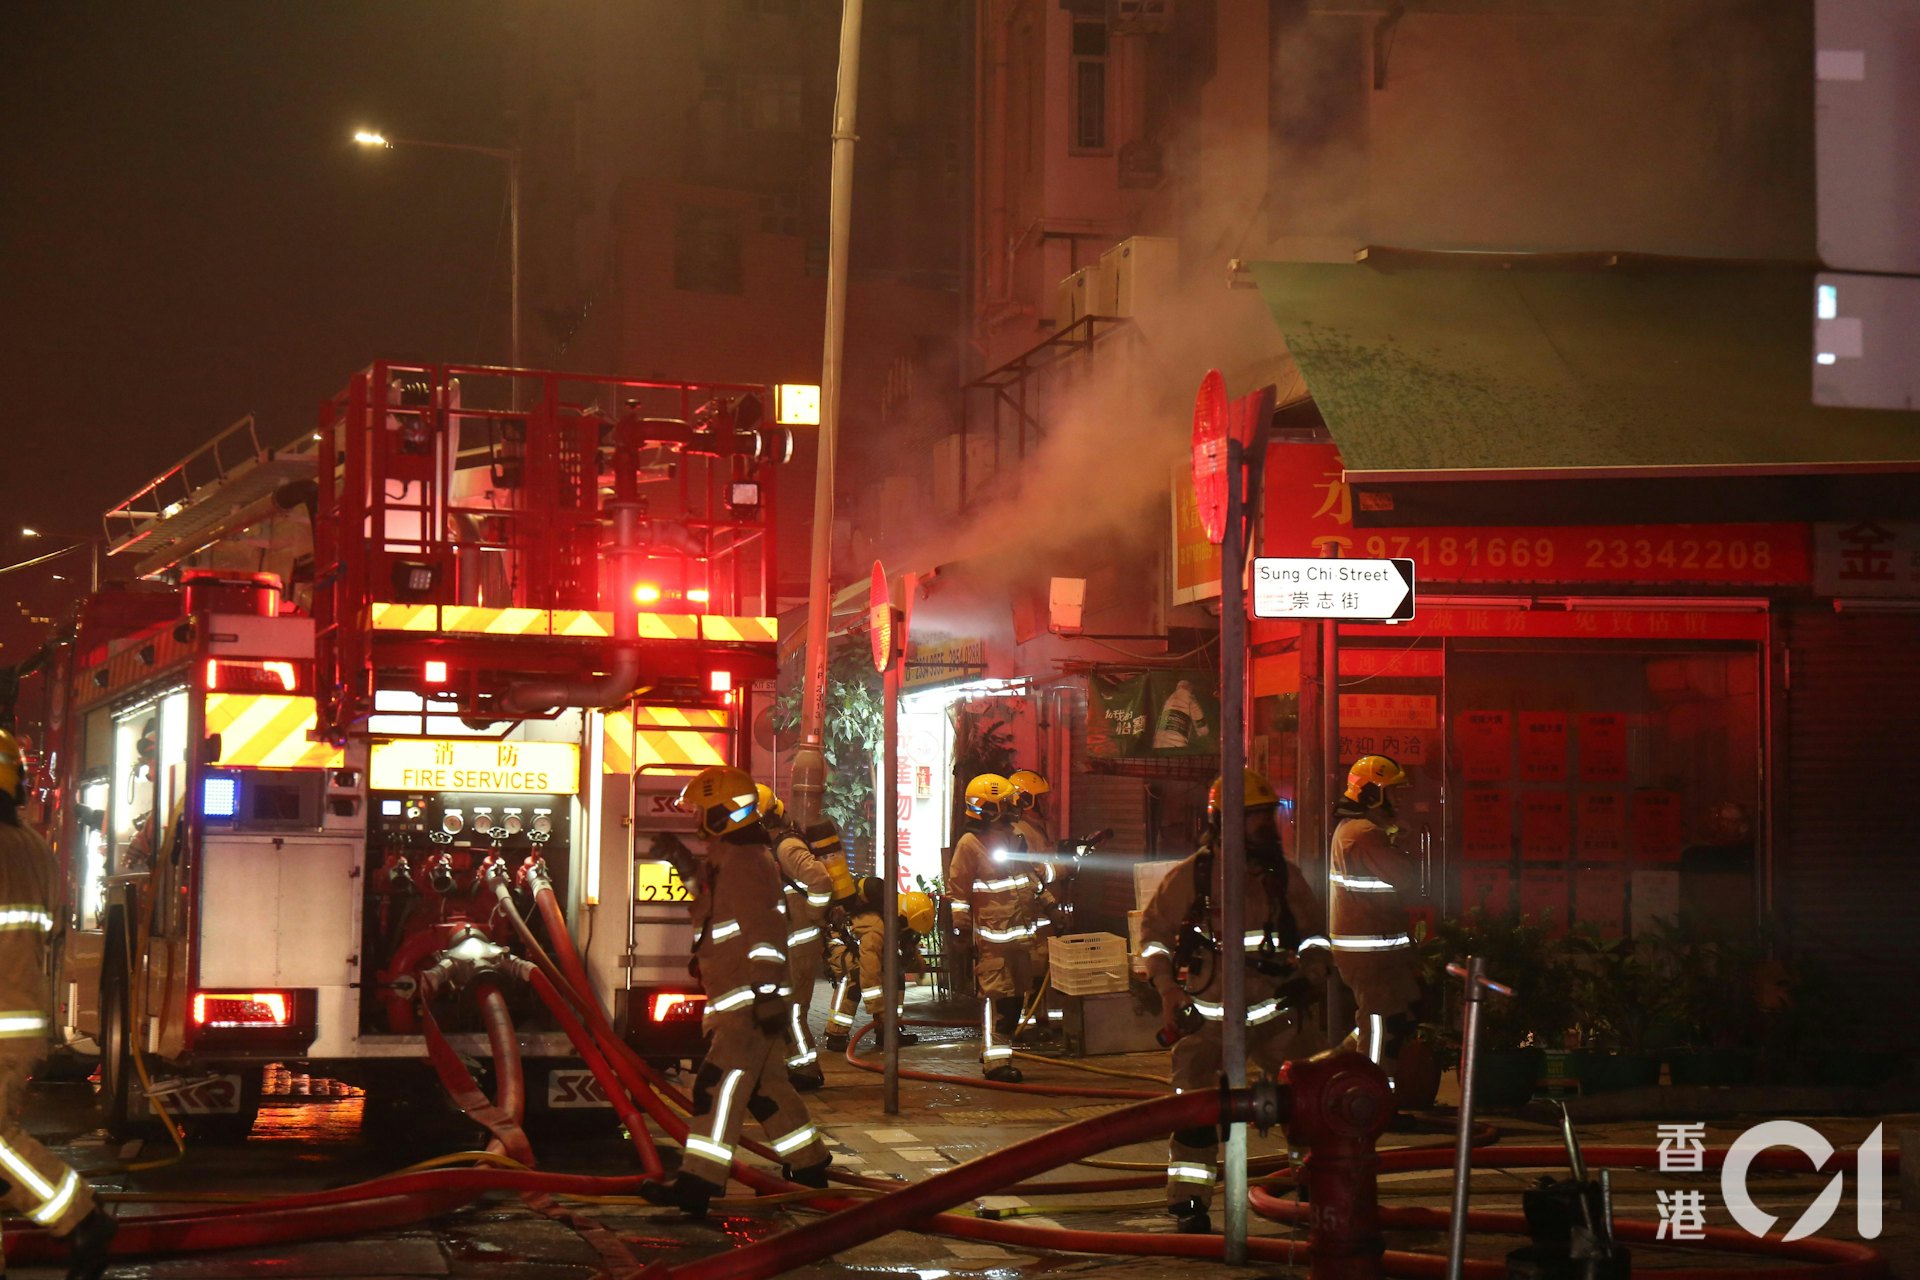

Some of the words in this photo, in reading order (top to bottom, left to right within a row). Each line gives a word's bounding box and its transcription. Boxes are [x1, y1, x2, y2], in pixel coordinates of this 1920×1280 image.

[1366, 536, 1555, 568] 97181669
[1585, 538, 1772, 571] 23342208
[1838, 519, 1896, 580] 金
[1260, 566, 1300, 583] Sung
[1306, 566, 1332, 581] Chi
[1339, 567, 1389, 582] Street
[1291, 591, 1360, 611] 崇志街
[435, 743, 519, 767] 消防
[402, 769, 447, 788] FIRE
[452, 770, 549, 790] SERVICES
